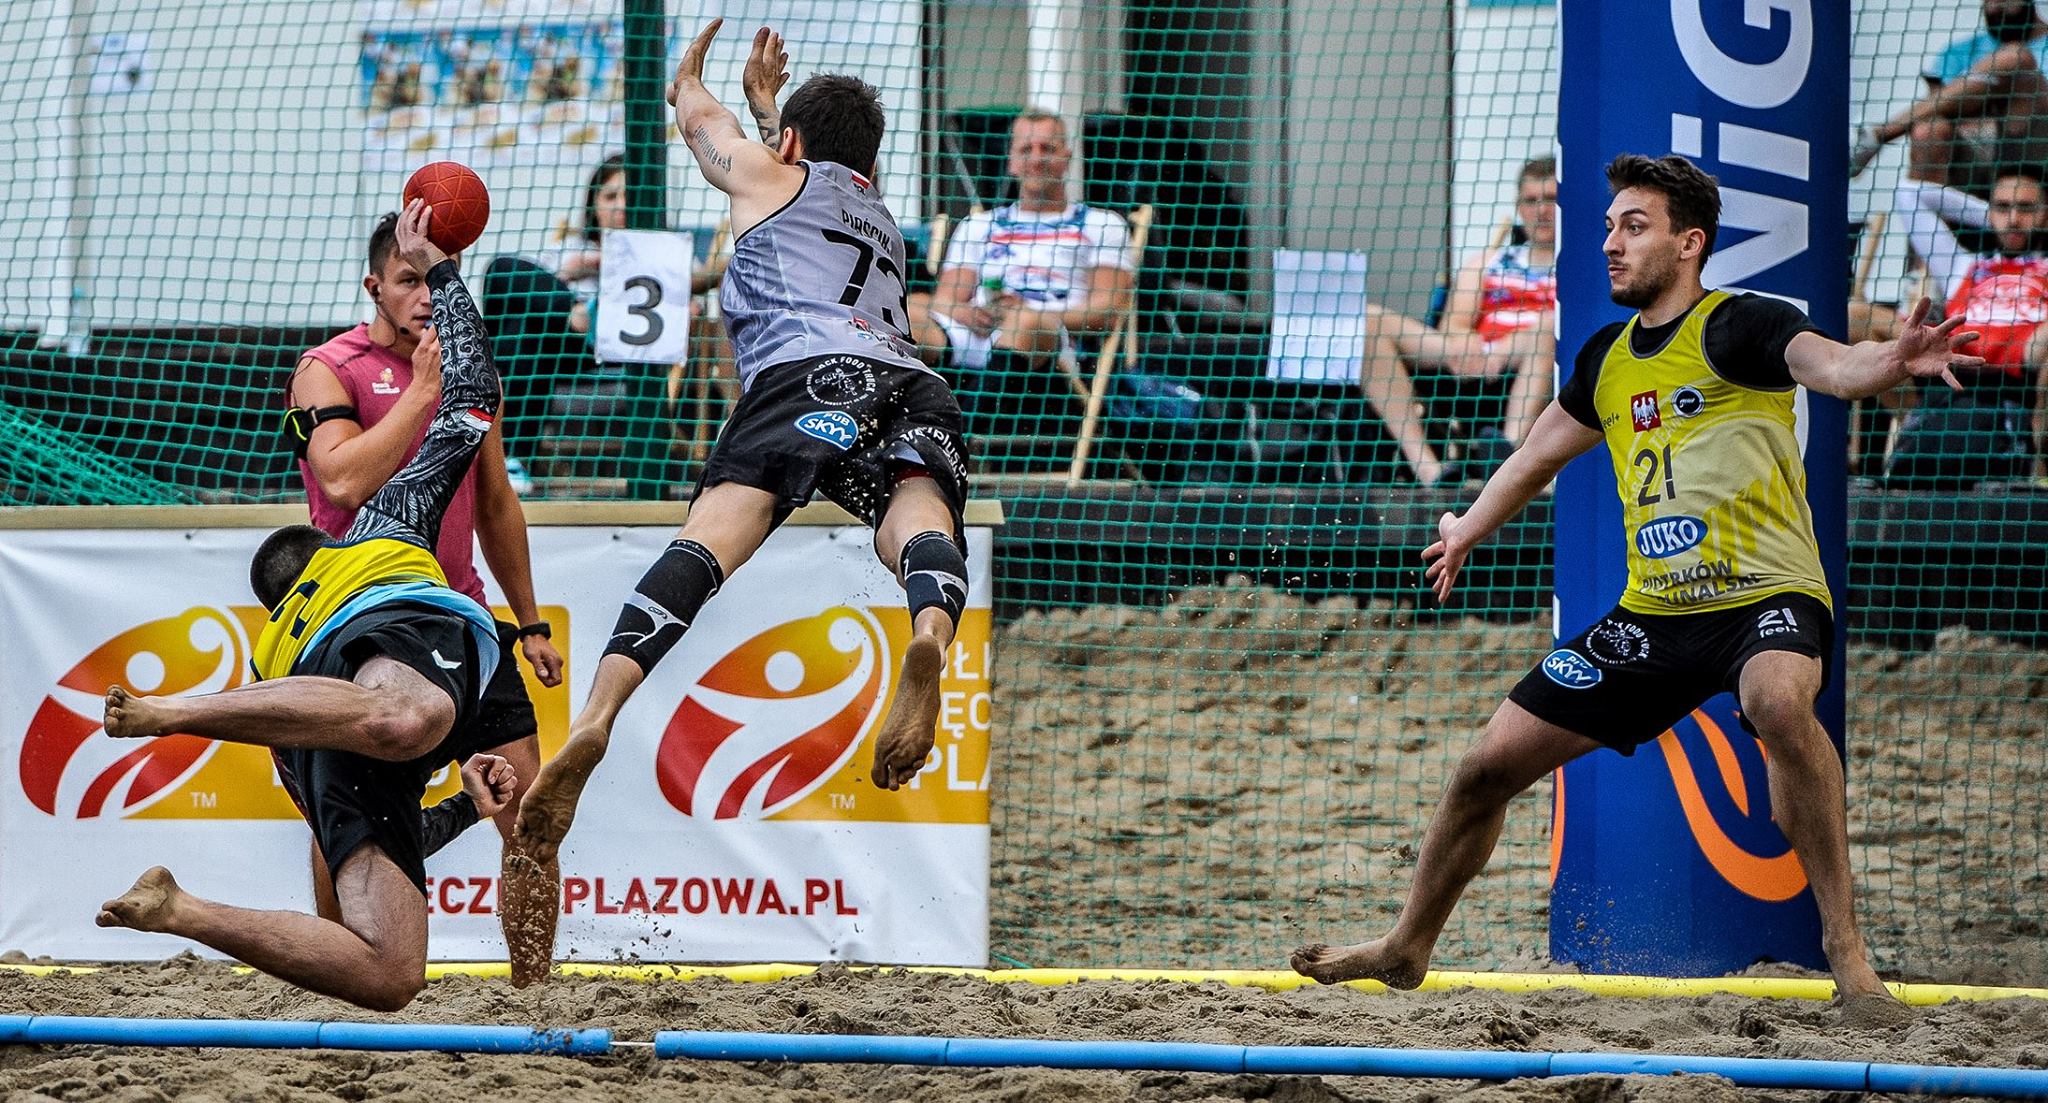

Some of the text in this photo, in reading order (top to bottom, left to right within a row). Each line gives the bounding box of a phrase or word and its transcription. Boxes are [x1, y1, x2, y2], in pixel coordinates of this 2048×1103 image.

[821, 229, 917, 344] 73
[619, 275, 664, 346] 3
[840, 356, 865, 370] FOOD
[804, 418, 853, 442] SKYY
[823, 412, 850, 426] PUB
[1634, 443, 1676, 507] 21
[1640, 519, 1699, 557] JUKO
[1758, 607, 1797, 628] 21
[941, 691, 992, 739] ĘC
[190, 792, 217, 808] TM
[829, 793, 856, 809] TM
